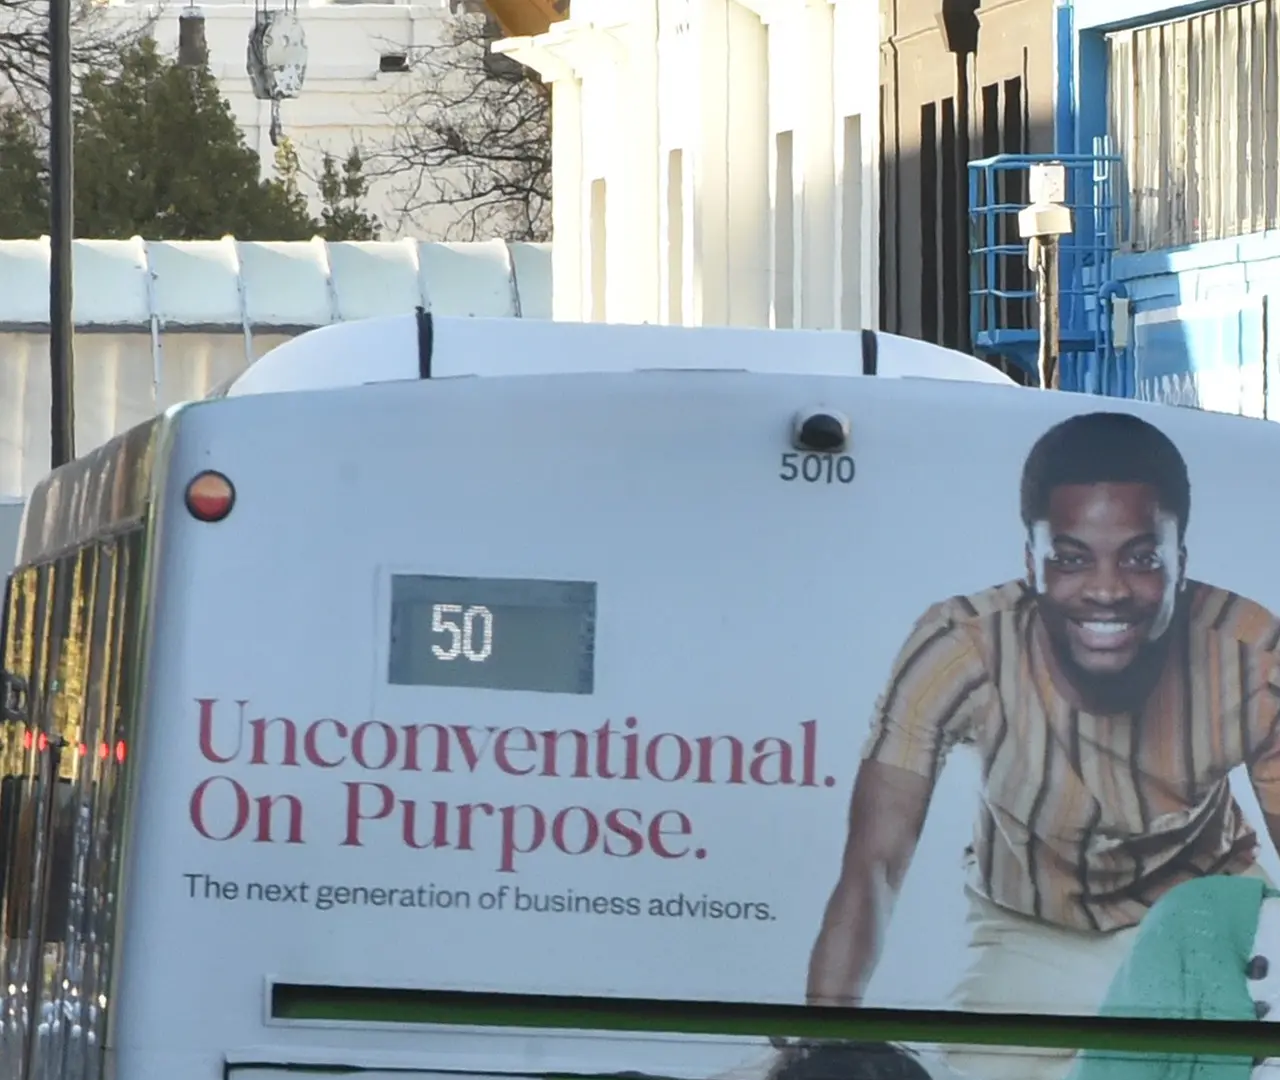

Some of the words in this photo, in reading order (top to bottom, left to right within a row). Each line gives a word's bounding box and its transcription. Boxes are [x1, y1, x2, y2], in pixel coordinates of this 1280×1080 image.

[780, 454, 856, 485] 5010
[431, 605, 493, 662] 50
[195, 699, 837, 790] Unconventional.
[190, 776, 304, 845] On
[341, 782, 707, 873] Purpose.
[183, 873, 239, 901] The
[246, 881, 309, 903] next
[315, 883, 471, 911] generation
[478, 885, 511, 910] of
[514, 886, 642, 916] business
[648, 893, 777, 922] advisors.
